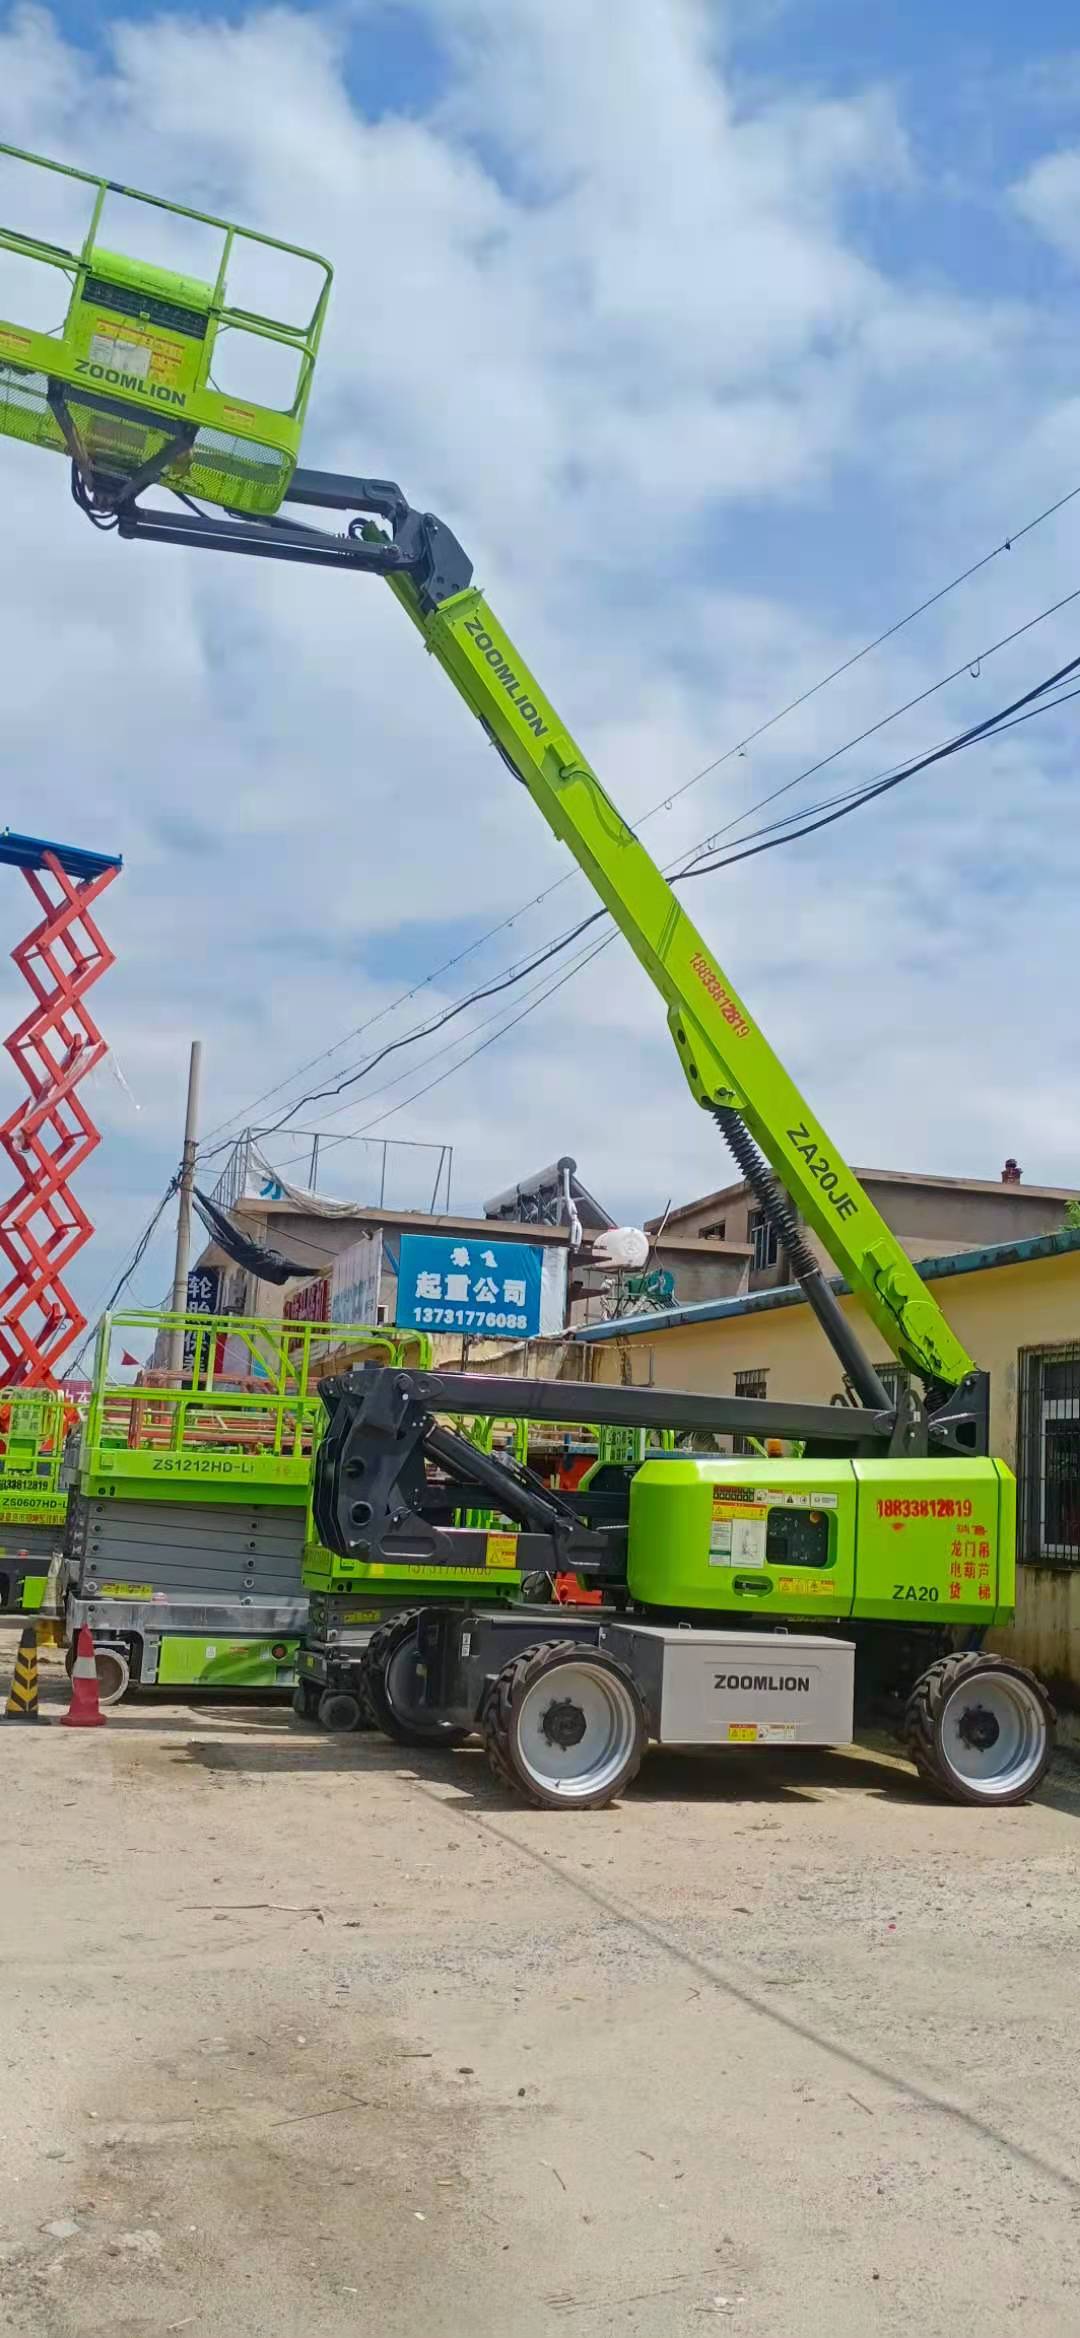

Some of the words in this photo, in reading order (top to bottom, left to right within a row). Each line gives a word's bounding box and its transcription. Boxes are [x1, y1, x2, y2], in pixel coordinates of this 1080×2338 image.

[74, 359, 187, 407] ZOOMLION
[464, 616, 549, 737] ZOOMLION
[690, 952, 750, 1038] 18833812819
[787, 1122, 858, 1221] ZA20JE
[415, 1271, 527, 1307] 起重公司
[413, 1307, 528, 1330] 13731776088
[876, 1499, 972, 1518] 18833812819
[892, 1584, 939, 1602] ZA20
[714, 1674, 810, 1692] ZOOMLION
